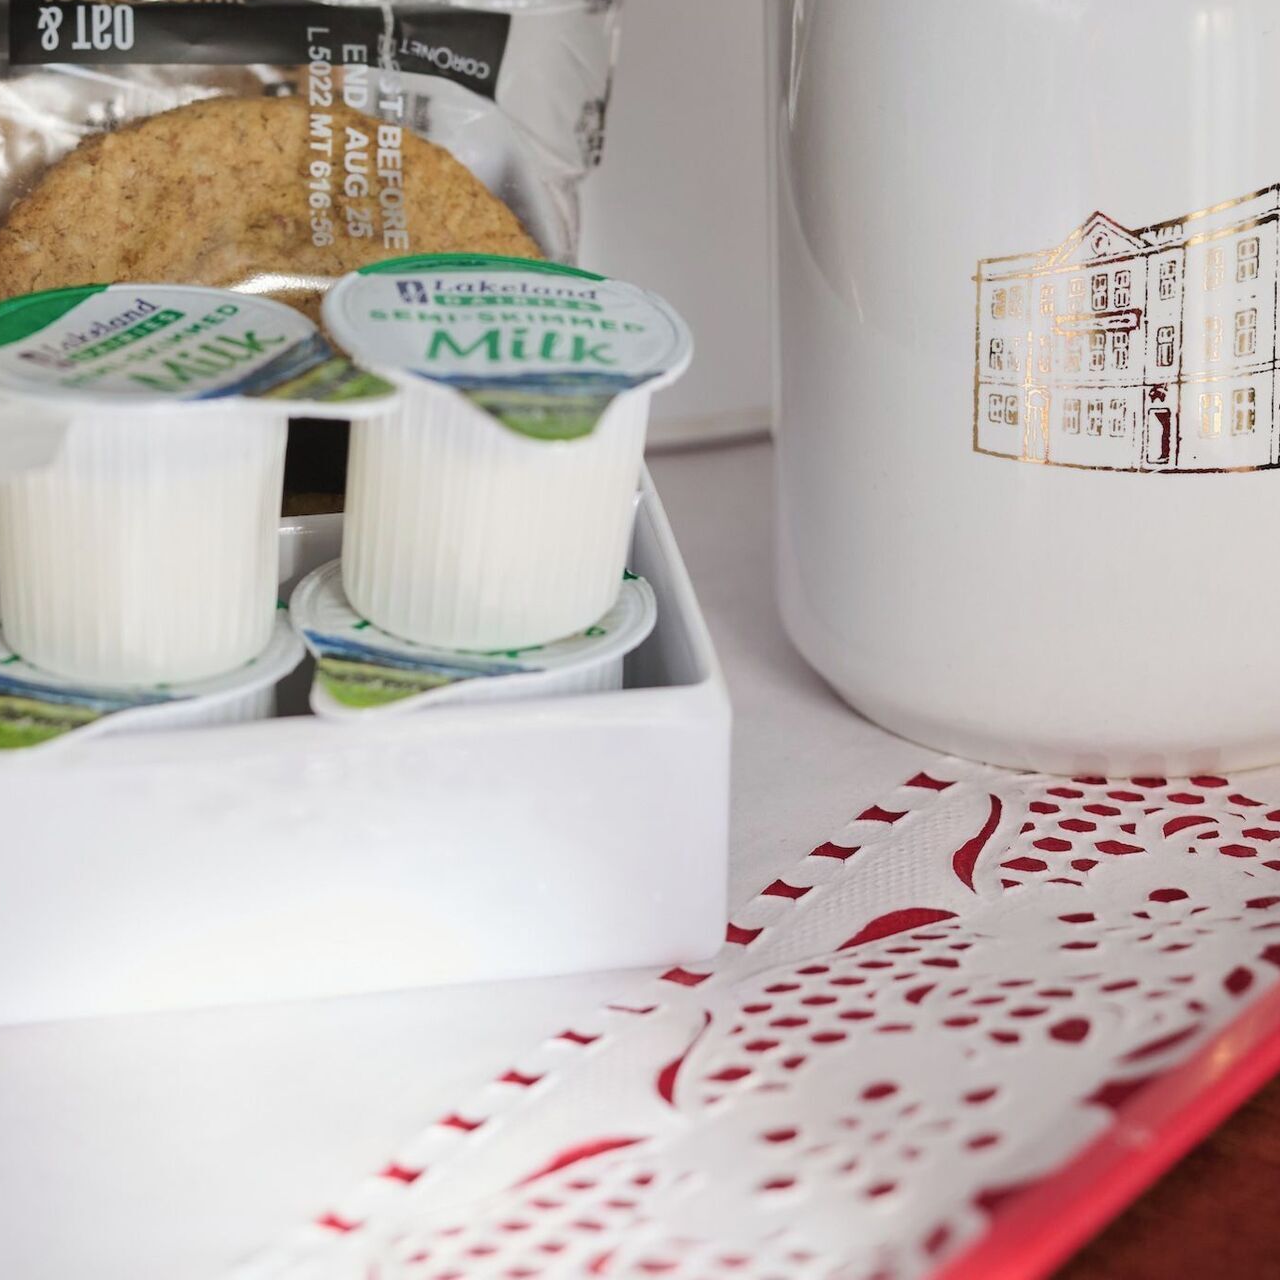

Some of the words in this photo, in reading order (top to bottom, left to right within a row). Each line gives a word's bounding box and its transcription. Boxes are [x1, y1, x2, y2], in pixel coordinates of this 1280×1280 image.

[37, 5, 64, 51] &
[307, 26, 330, 42] L
[308, 45, 333, 108] 5022
[342, 43, 368, 109] END
[399, 39, 491, 80] CORONET
[310, 114, 333, 157] MT
[343, 127, 369, 199] AUG
[377, 124, 409, 252] BEFORE
[347, 206, 373, 239] 25
[433, 279, 598, 301] Lakeland
[369, 309, 646, 334] SEMI-SKIMMED
[127, 330, 287, 392] Milk
[424, 327, 621, 366] Milk
